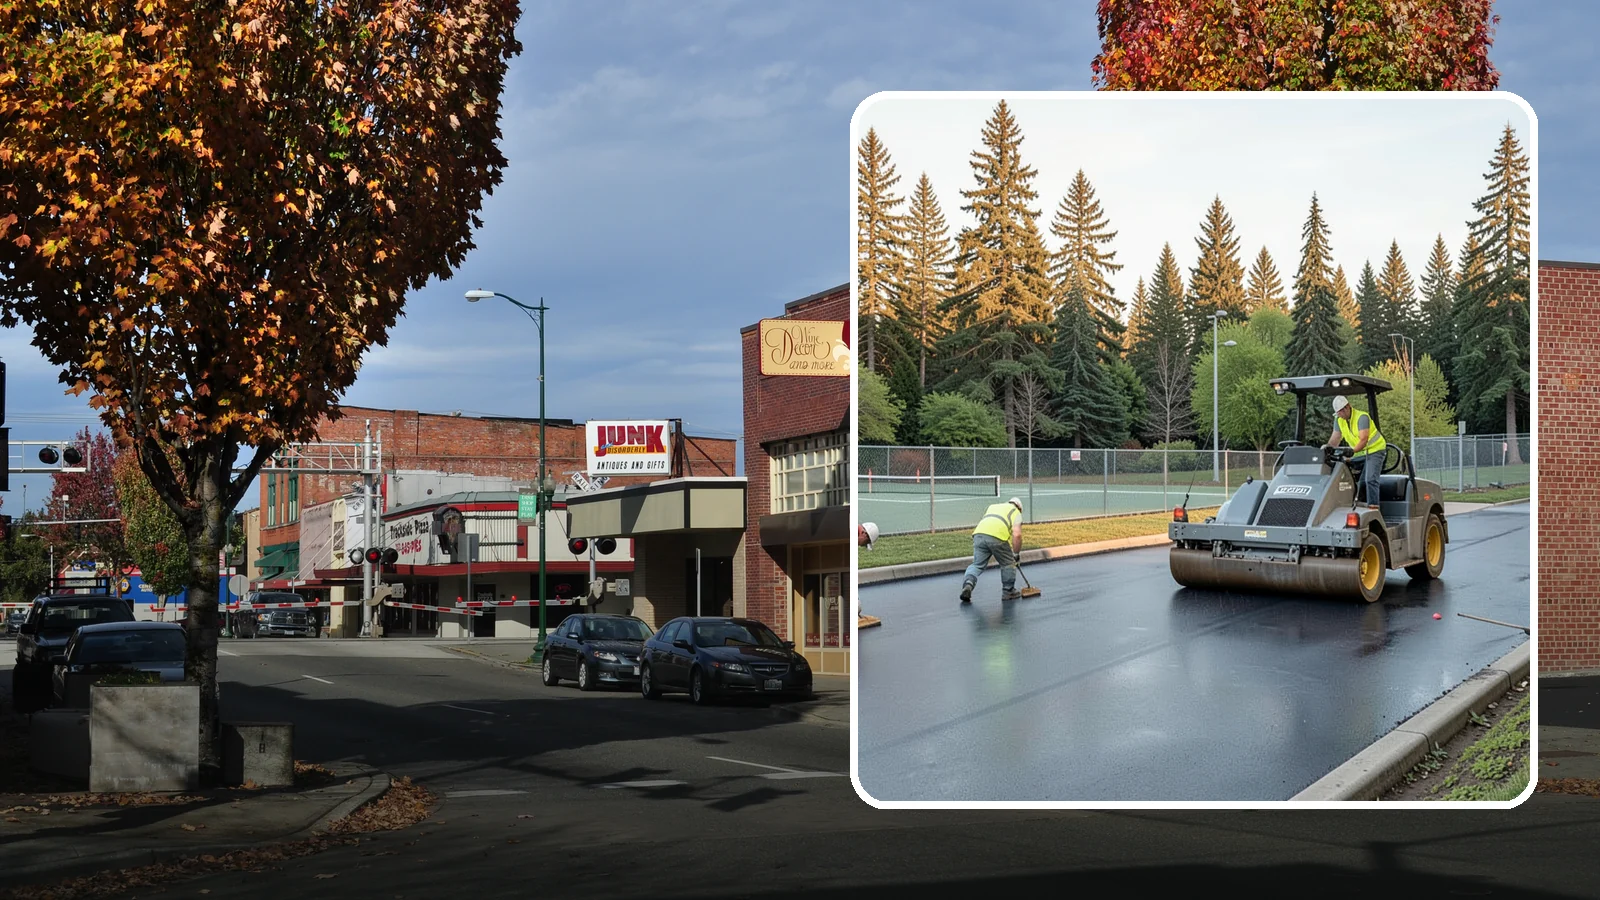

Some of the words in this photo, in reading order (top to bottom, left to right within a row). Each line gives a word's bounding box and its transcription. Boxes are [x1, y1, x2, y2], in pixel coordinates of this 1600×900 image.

[596, 425, 665, 457] JUNK
[607, 446, 646, 454] DISORDERLY
[596, 461, 628, 470] ANTIQUES
[631, 461, 644, 470] AND
[647, 460, 665, 469] GIFTS
